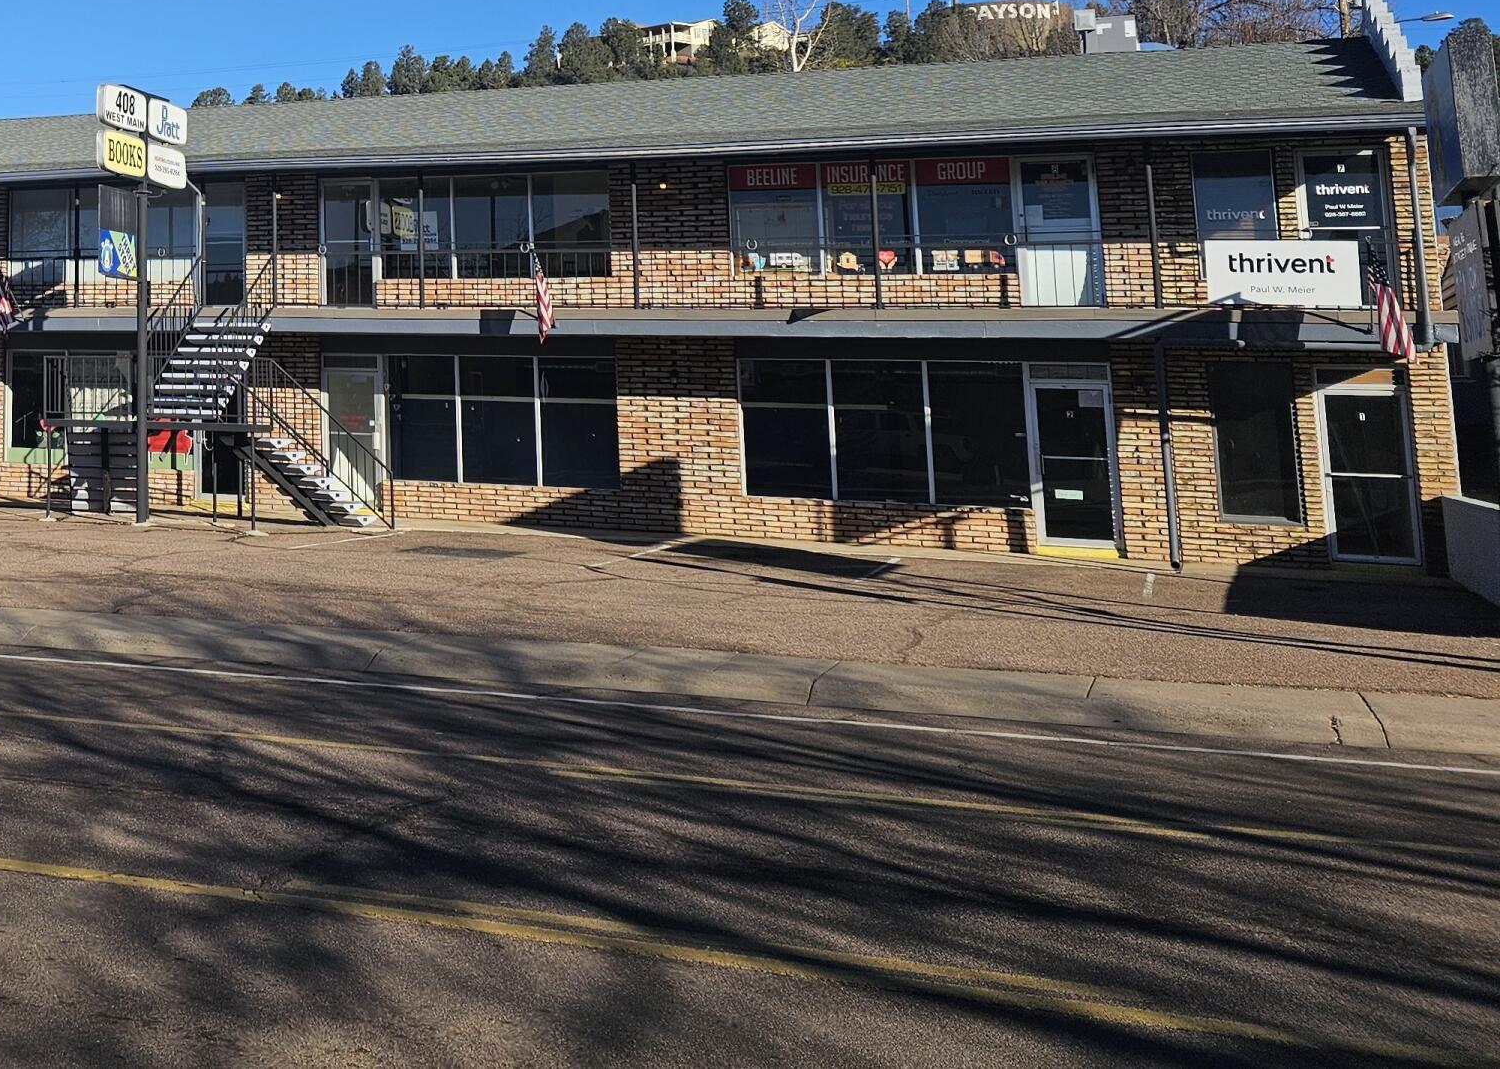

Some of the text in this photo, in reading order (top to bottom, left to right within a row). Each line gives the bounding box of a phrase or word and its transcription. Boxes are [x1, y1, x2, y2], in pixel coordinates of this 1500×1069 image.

[115, 91, 135, 115] 408
[105, 110, 145, 129] WEST MAIN
[156, 104, 180, 140] Pratt
[108, 138, 143, 169] BOOKS
[746, 161, 986, 186] BEELINE INSURNCE GROUP
[831, 183, 902, 195] 928-47-7151
[1316, 184, 1370, 195] thrivent
[1206, 207, 1266, 220] thrivent
[118, 243, 131, 276] STORE
[122, 235, 137, 271] THRIFT
[1228, 253, 1336, 273] thrivent
[1250, 285, 1270, 293] Paul
[1288, 285, 1316, 294] Meier
